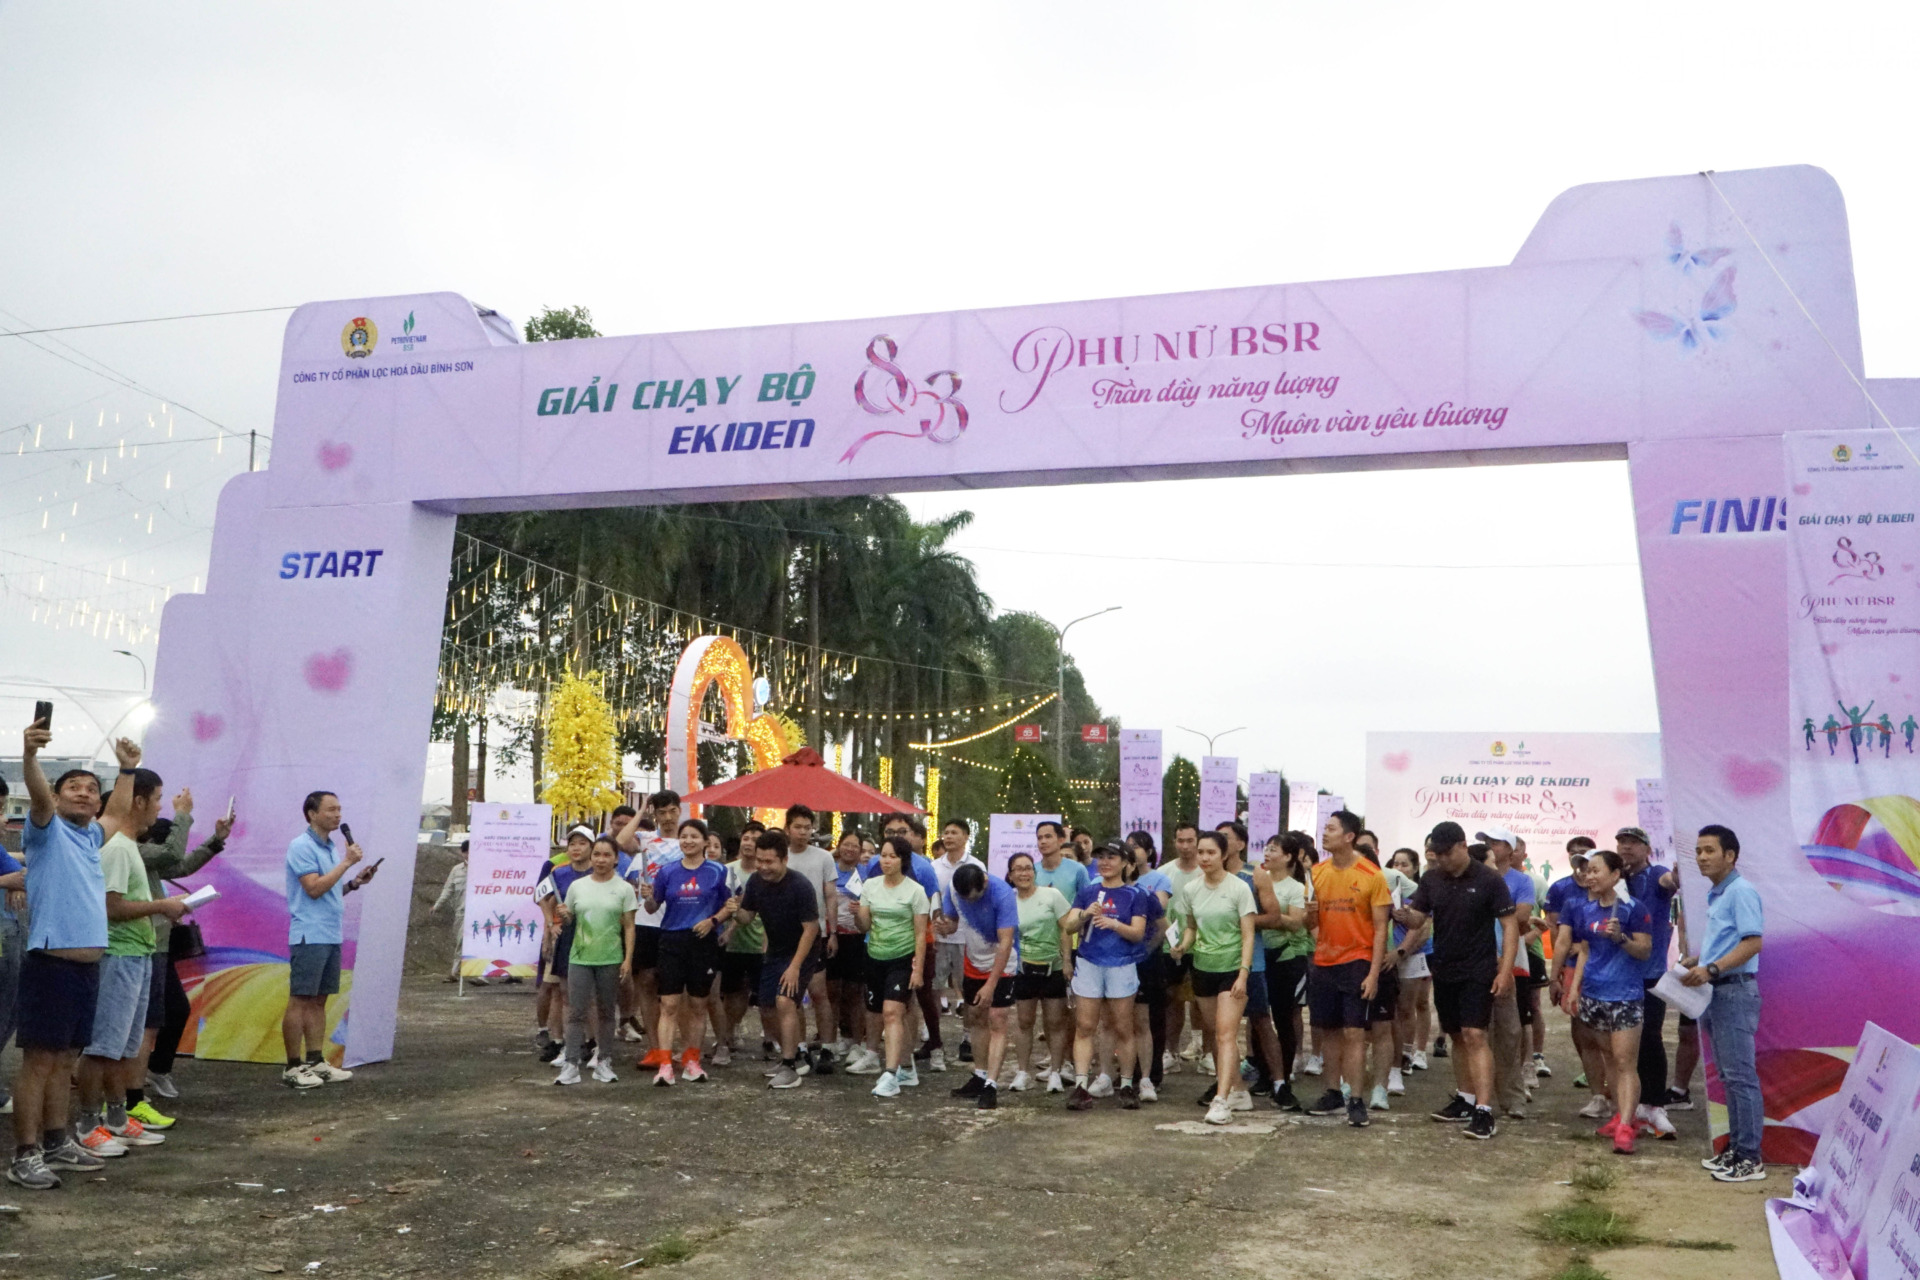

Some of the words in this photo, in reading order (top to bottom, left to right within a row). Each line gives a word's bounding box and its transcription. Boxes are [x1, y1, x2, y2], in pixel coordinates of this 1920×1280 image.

[391, 335, 427, 345] PETROVIETNAM
[1153, 324, 1218, 362] NỮ
[1230, 321, 1321, 356] BSR
[293, 373, 317, 384] CÔNG
[319, 371, 330, 382] TY
[345, 367, 370, 380] PHẦN
[372, 367, 388, 379] LỌC
[390, 363, 408, 377] HOÁ
[410, 362, 429, 376] DẦU
[430, 361, 452, 374] BÌNH
[454, 360, 474, 373] SƠN
[537, 376, 619, 417] GIẢI
[632, 375, 742, 414] CHẠY
[757, 363, 817, 407] BỘ
[1156, 377, 1201, 408] đầy
[1207, 376, 1271, 403] năng
[1273, 371, 1340, 399] lượng
[667, 418, 816, 455] EKIDEN
[1240, 408, 1322, 444] Muôn
[1325, 409, 1372, 432] vàn
[1371, 407, 1419, 437] yêu
[1422, 401, 1509, 431] thương
[1824, 514, 1852, 527] CHẠY
[1857, 512, 1873, 526] BỘ
[1876, 513, 1915, 524] EKIDEN
[279, 549, 384, 580] START
[1473, 776, 1510, 788] CHẠY
[1515, 775, 1535, 788] BỘ
[1539, 777, 1591, 788] EKIDEN
[1498, 793, 1532, 805] BSR
